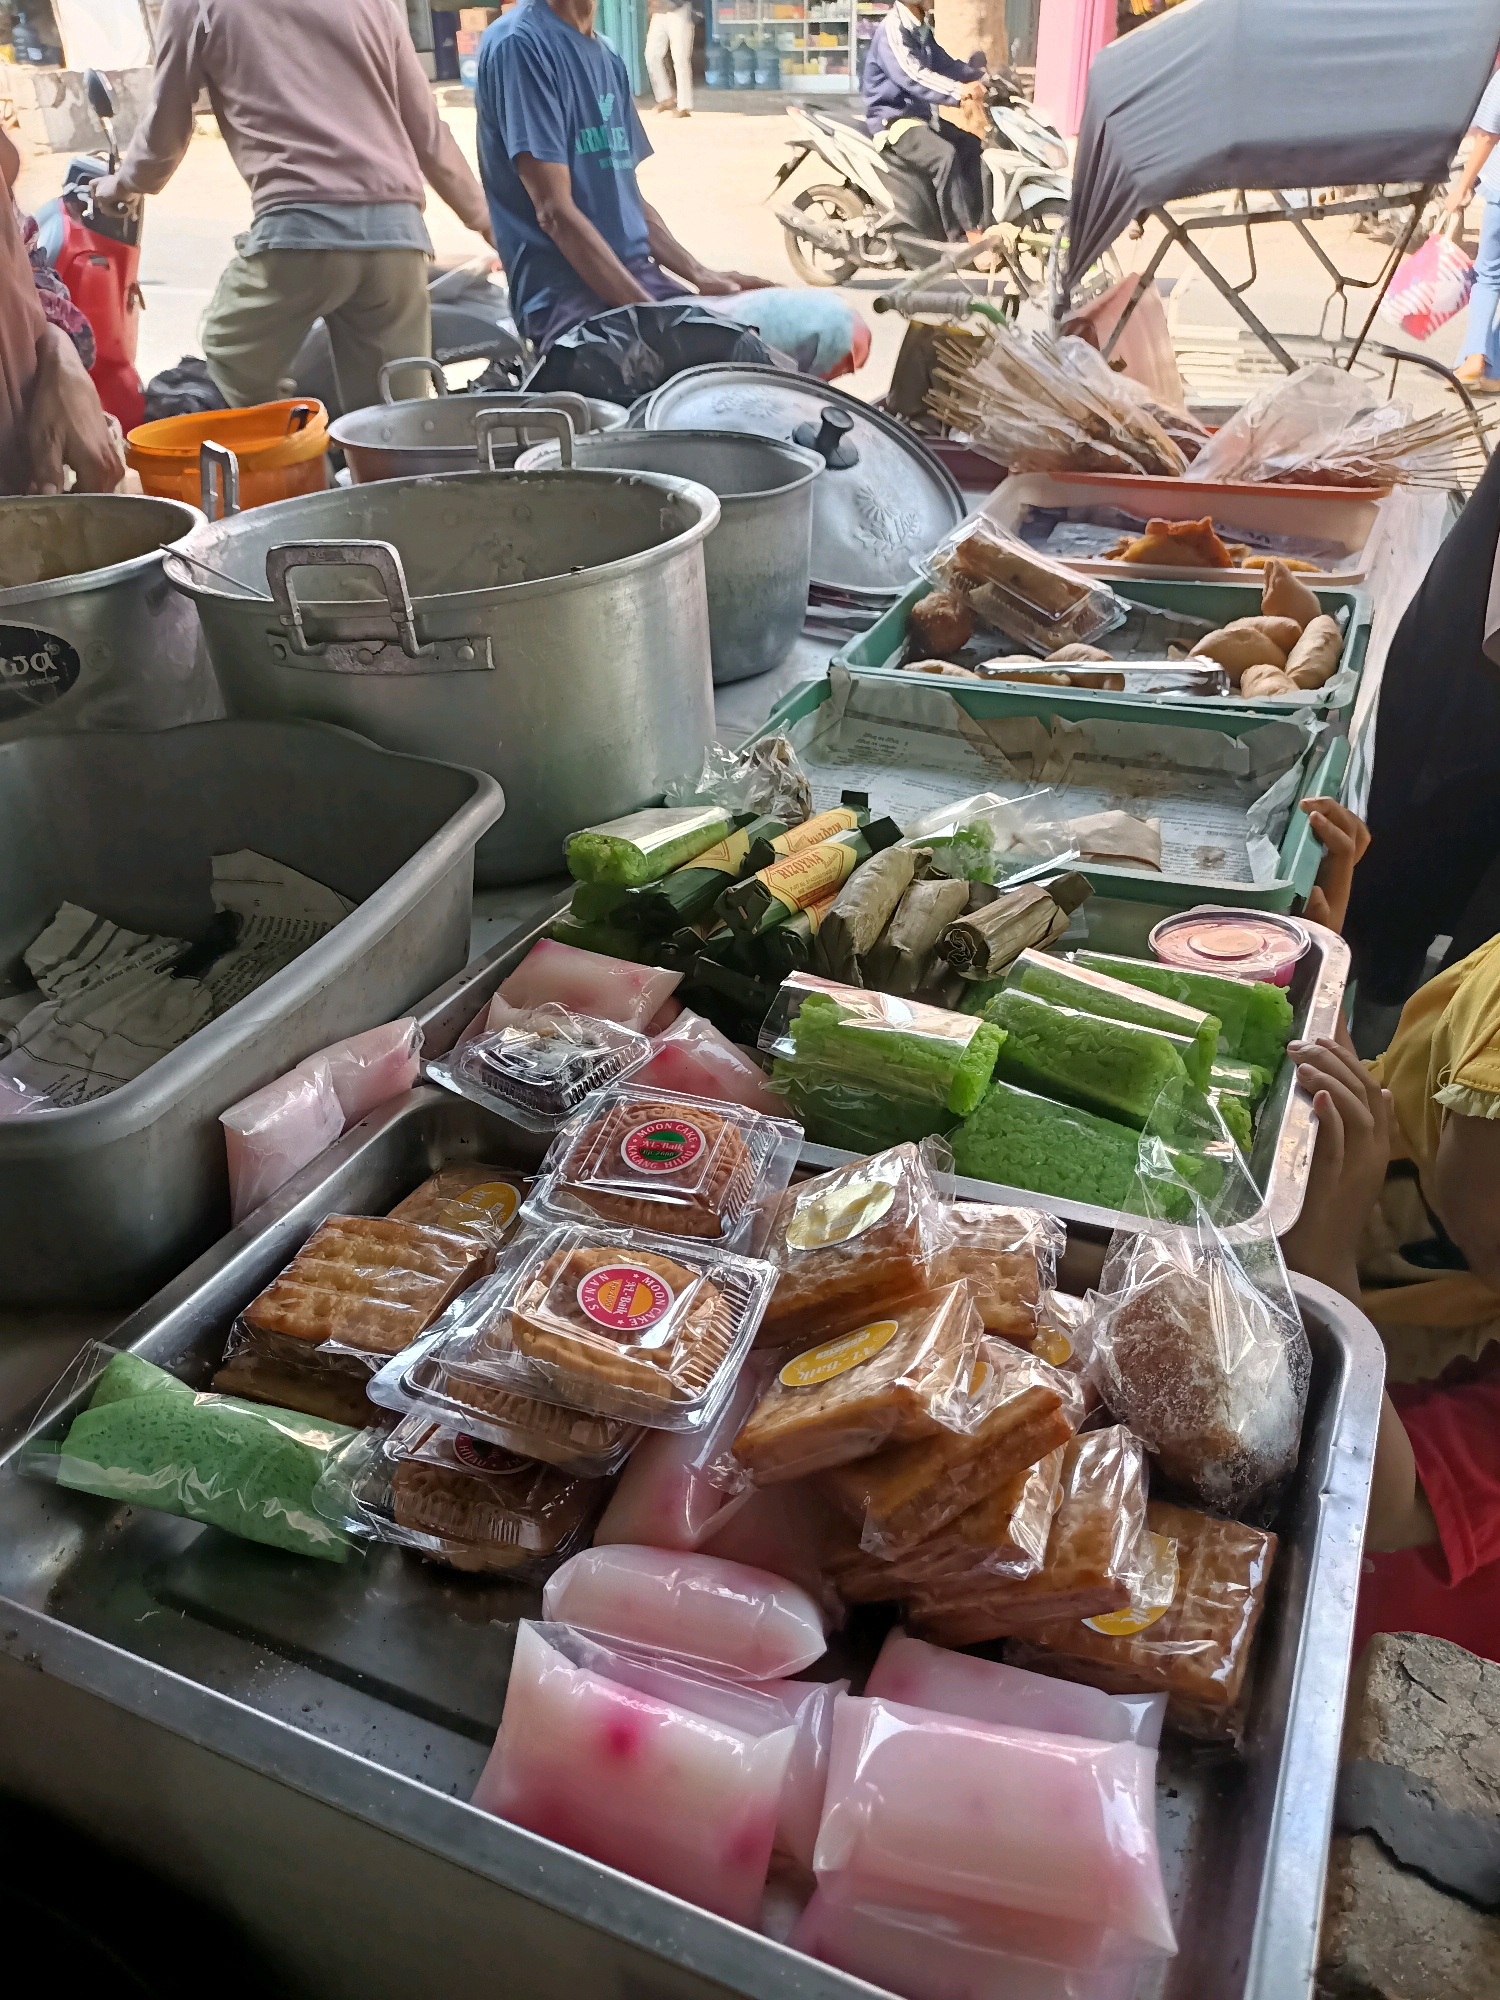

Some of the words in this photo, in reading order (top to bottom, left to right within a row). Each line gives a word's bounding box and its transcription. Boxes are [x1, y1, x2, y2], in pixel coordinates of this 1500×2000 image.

[637, 1122, 673, 1138] MOON
[675, 1124, 698, 1143] CAKE
[628, 1145, 658, 1169] KACANG
[664, 1150, 694, 1169] HIJAU
[584, 1273, 610, 1311] NANAS
[642, 1276, 666, 1306] MOON
[628, 1307, 662, 1326] CAKE
